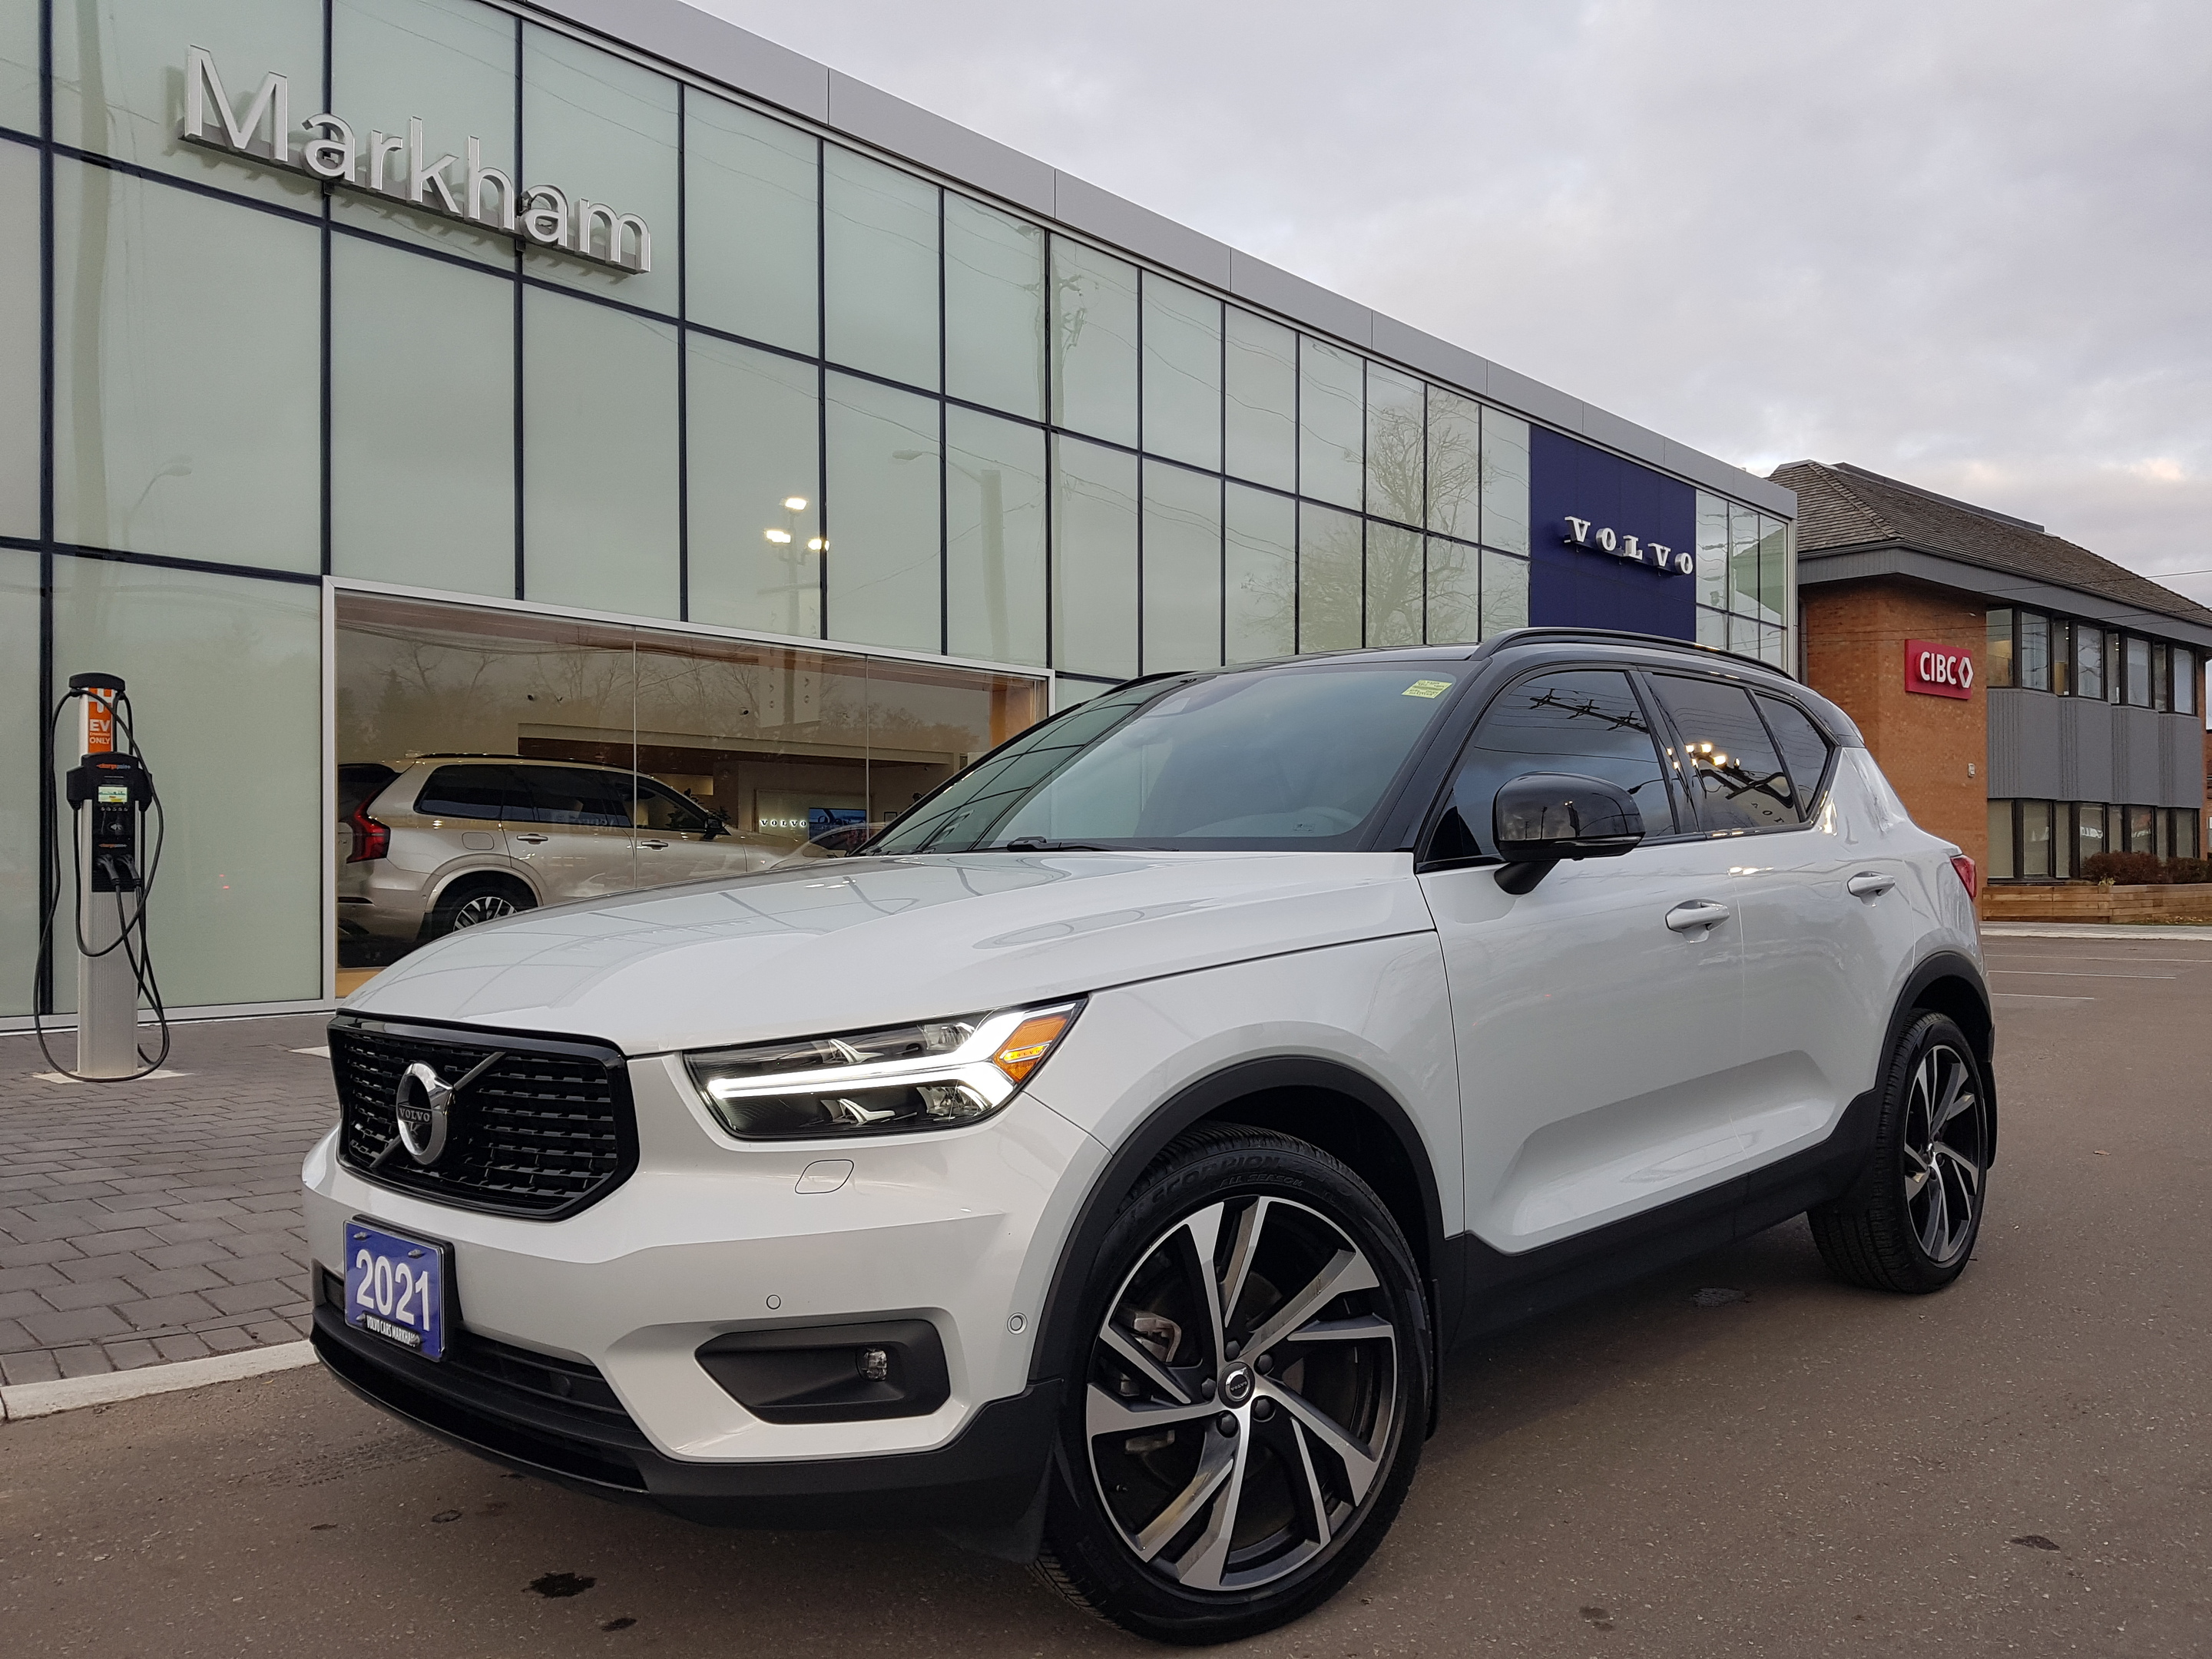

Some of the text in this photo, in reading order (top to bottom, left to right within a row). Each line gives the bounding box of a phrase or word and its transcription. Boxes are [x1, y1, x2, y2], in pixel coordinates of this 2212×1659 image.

[183, 44, 651, 273] Markham
[1564, 515, 1694, 575] VOLVO
[1920, 651, 1957, 685] CIBC
[89, 719, 111, 732] EV
[89, 737, 111, 745] ONLY
[760, 819, 807, 827] VOLVO
[399, 1108, 430, 1122] VOLVO
[1219, 1174, 1305, 1188] ALL SEASON
[356, 1248, 430, 1332] 2021
[366, 1315, 380, 1333] VOLVO
[380, 1321, 392, 1337] CARS
